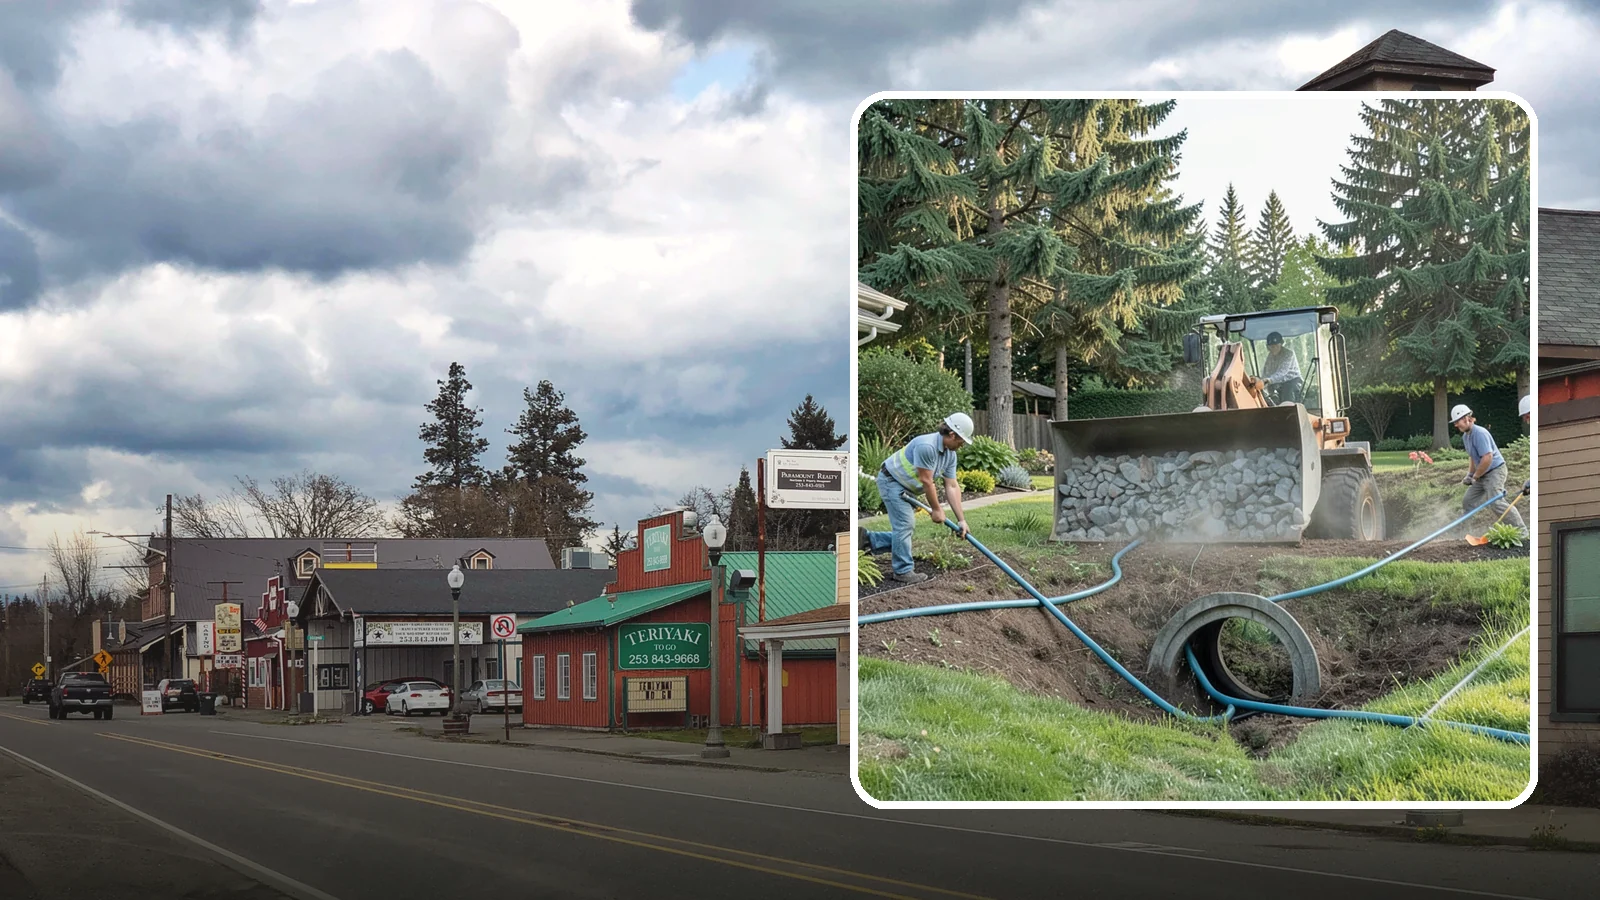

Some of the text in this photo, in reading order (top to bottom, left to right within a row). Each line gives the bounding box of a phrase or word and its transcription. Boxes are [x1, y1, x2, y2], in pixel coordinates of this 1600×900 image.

[781, 471, 839, 480] PARAMOUNT REALTY
[624, 627, 702, 646] TERIYAKI
[628, 653, 700, 665] 253 843-9668
[639, 681, 672, 691] TERIYAKI
